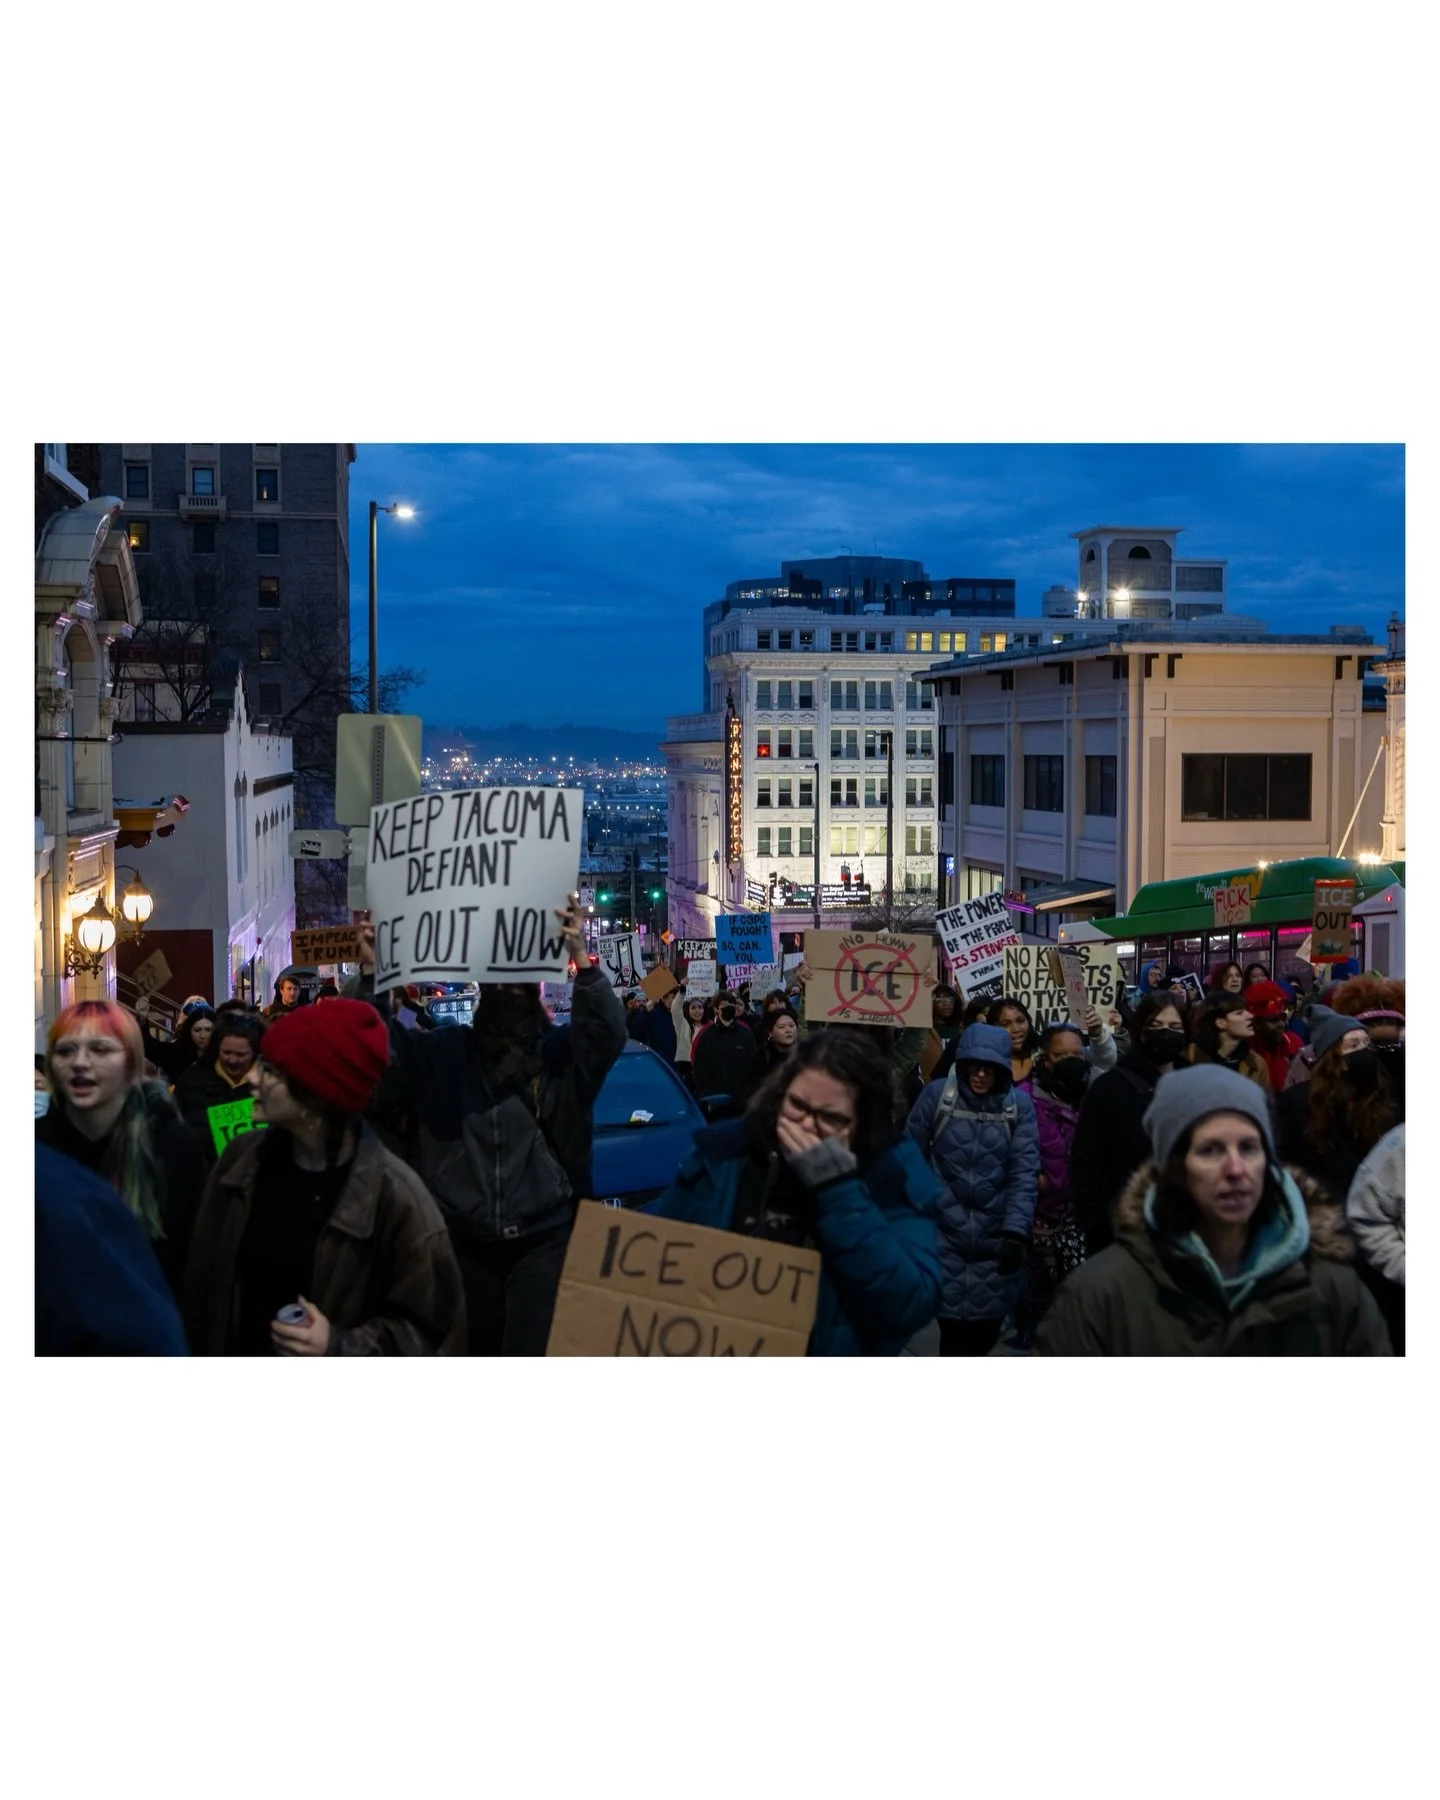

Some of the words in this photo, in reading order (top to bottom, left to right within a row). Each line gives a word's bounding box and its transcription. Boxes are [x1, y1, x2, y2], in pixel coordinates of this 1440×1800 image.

[731, 724, 740, 853] PANTAGES
[372, 795, 444, 863] KEEP
[452, 790, 570, 842] TACOMA
[407, 840, 518, 896] DEFIANT
[1215, 888, 1249, 912] FUCK
[1319, 889, 1350, 907] ICE
[729, 915, 737, 926] IF
[936, 908, 966, 932] THE
[964, 892, 1006, 923] POWER
[1315, 912, 1350, 930] OUT
[295, 931, 357, 947] IMPEAC
[415, 907, 479, 964] OUT
[491, 907, 566, 964] NOW
[730, 925, 769, 937] FOUGHT
[842, 934, 864, 948] NO
[946, 938, 959, 953] OF
[960, 927, 985, 946] THE
[678, 940, 700, 952] KEEP
[683, 950, 711, 960] NICE
[951, 954, 969, 969] IS
[970, 934, 1019, 963] STRONGER
[1006, 946, 1030, 968] NO
[851, 960, 903, 1000] ICE
[1005, 969, 1031, 991] NO
[600, 1225, 695, 1285] ICE
[712, 1252, 814, 1303] OUT
